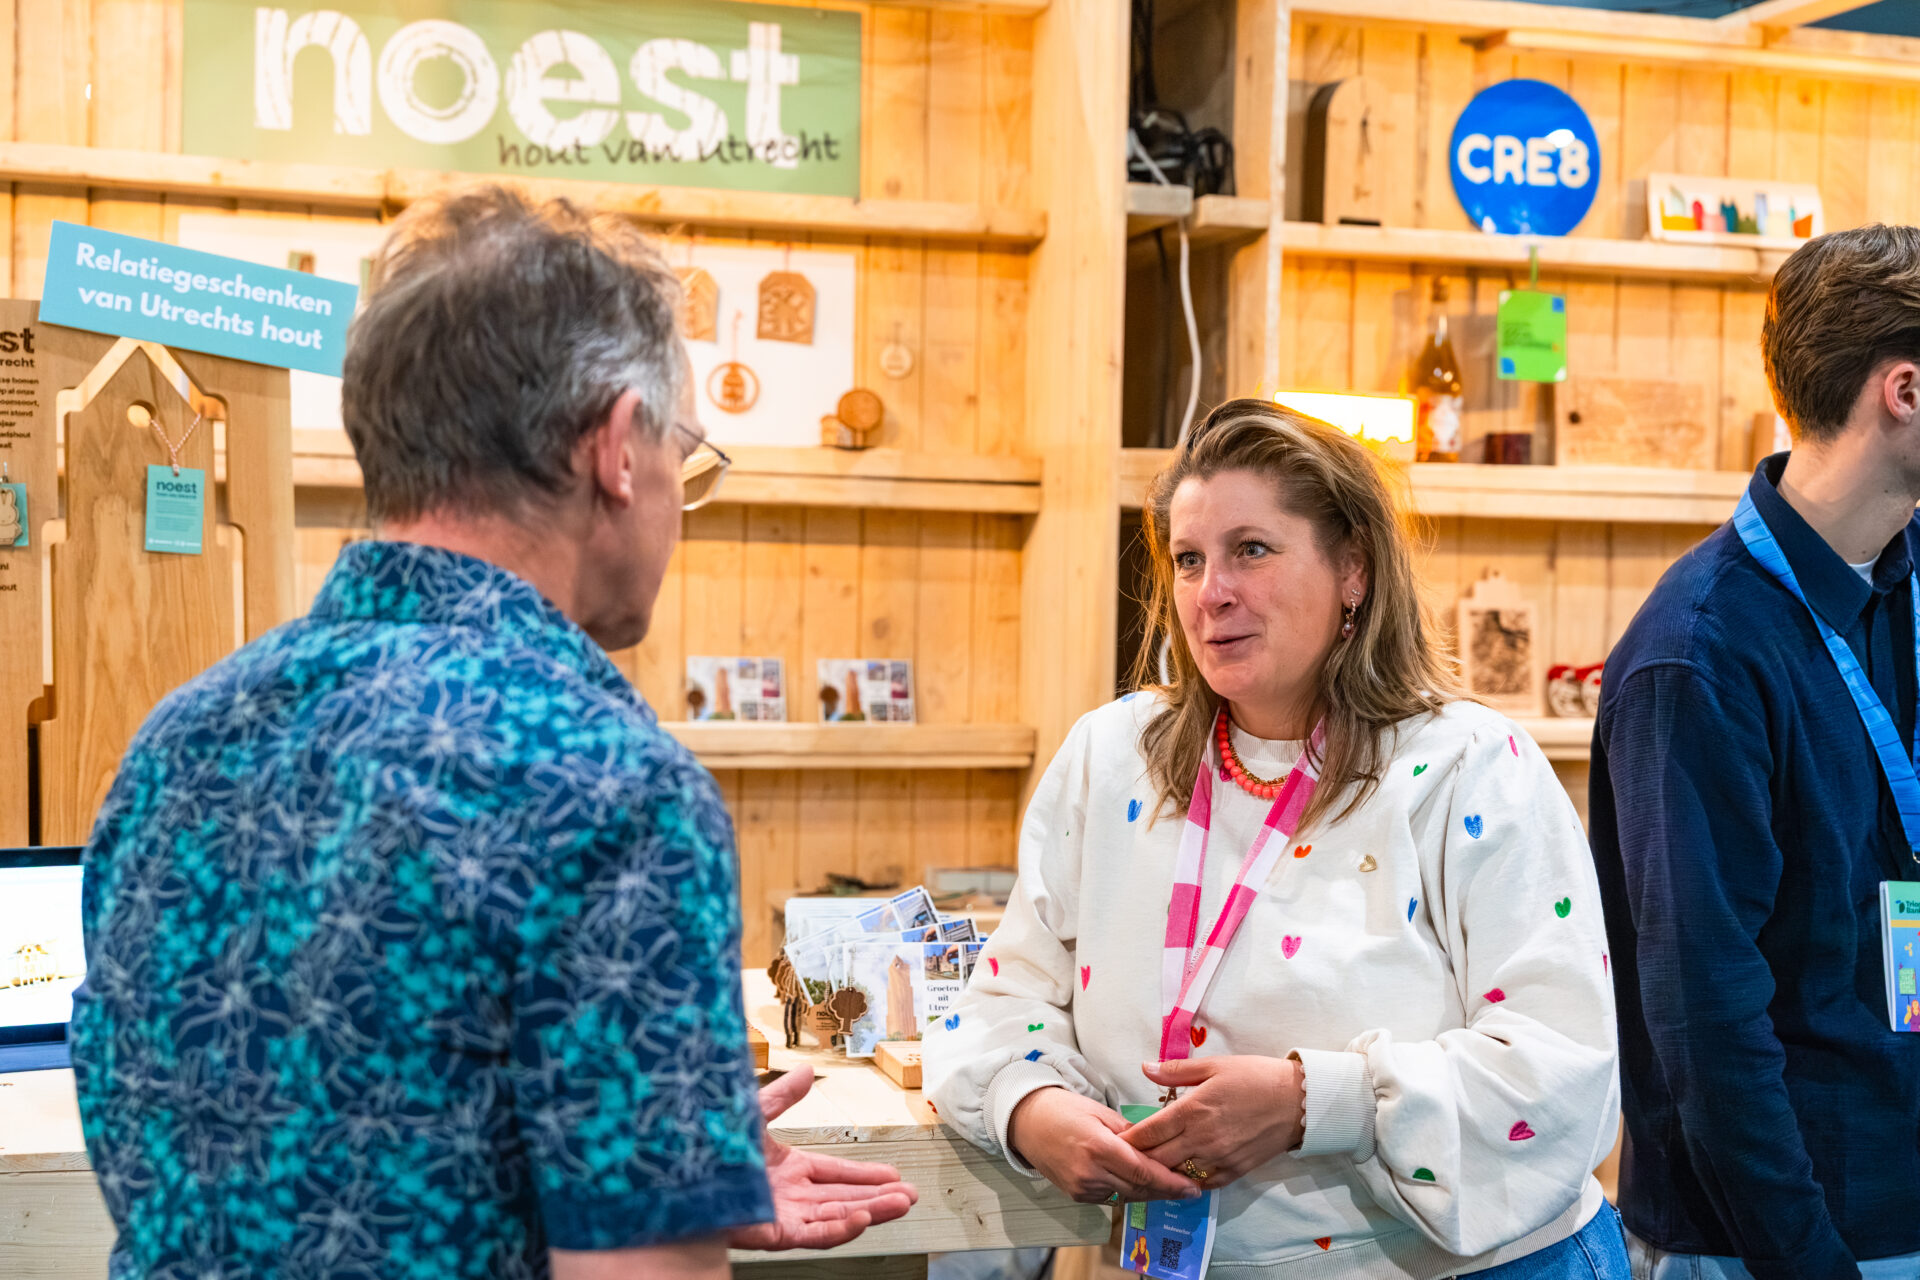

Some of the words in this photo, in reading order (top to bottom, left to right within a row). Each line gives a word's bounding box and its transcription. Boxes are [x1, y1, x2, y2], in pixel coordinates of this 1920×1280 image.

[255, 7, 798, 168] noest
[498, 134, 590, 167] hout
[603, 138, 682, 164] van
[1457, 133, 1590, 189] CRE8
[76, 242, 332, 316] Relatiegeschenken
[79, 287, 132, 312] van
[140, 292, 254, 336] Utrechts
[261, 315, 323, 350] hout
